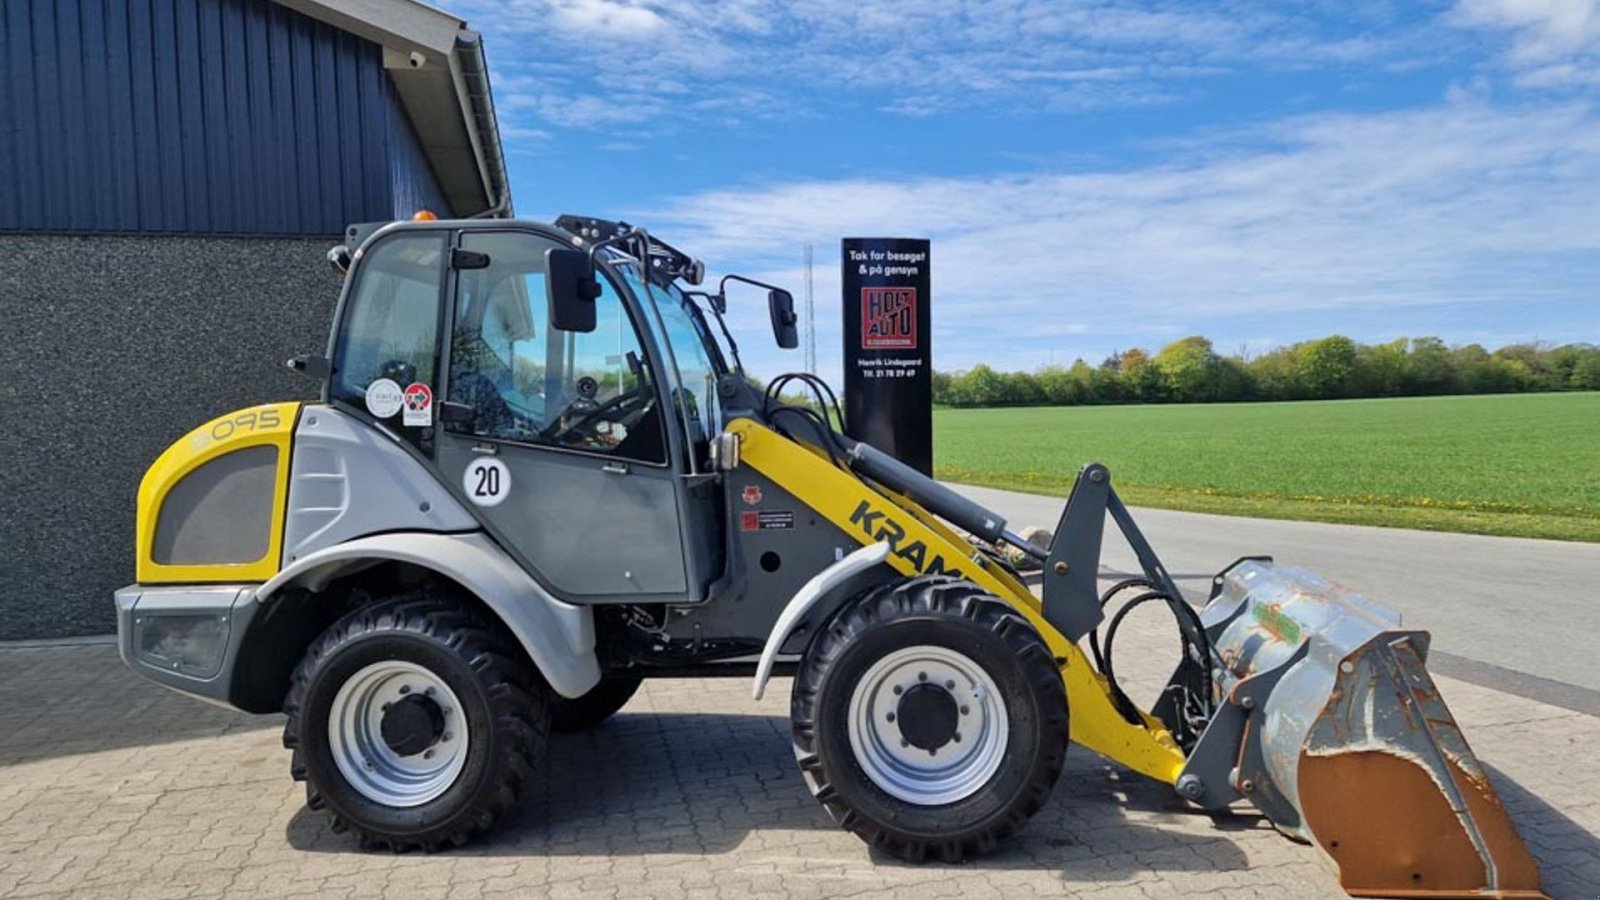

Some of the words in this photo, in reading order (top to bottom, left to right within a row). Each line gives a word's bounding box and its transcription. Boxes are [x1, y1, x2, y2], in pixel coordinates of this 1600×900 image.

[849, 250, 868, 260] Tak
[870, 250, 885, 260] for
[887, 250, 926, 263] besøget
[858, 264, 867, 274] &
[869, 264, 883, 276] på
[884, 266, 918, 277] gensyn
[869, 291, 910, 320] HOLT
[869, 306, 910, 335] AUTO
[858, 358, 882, 366] Henrik
[475, 466, 500, 496] 20
[849, 500, 969, 578] KRAM
